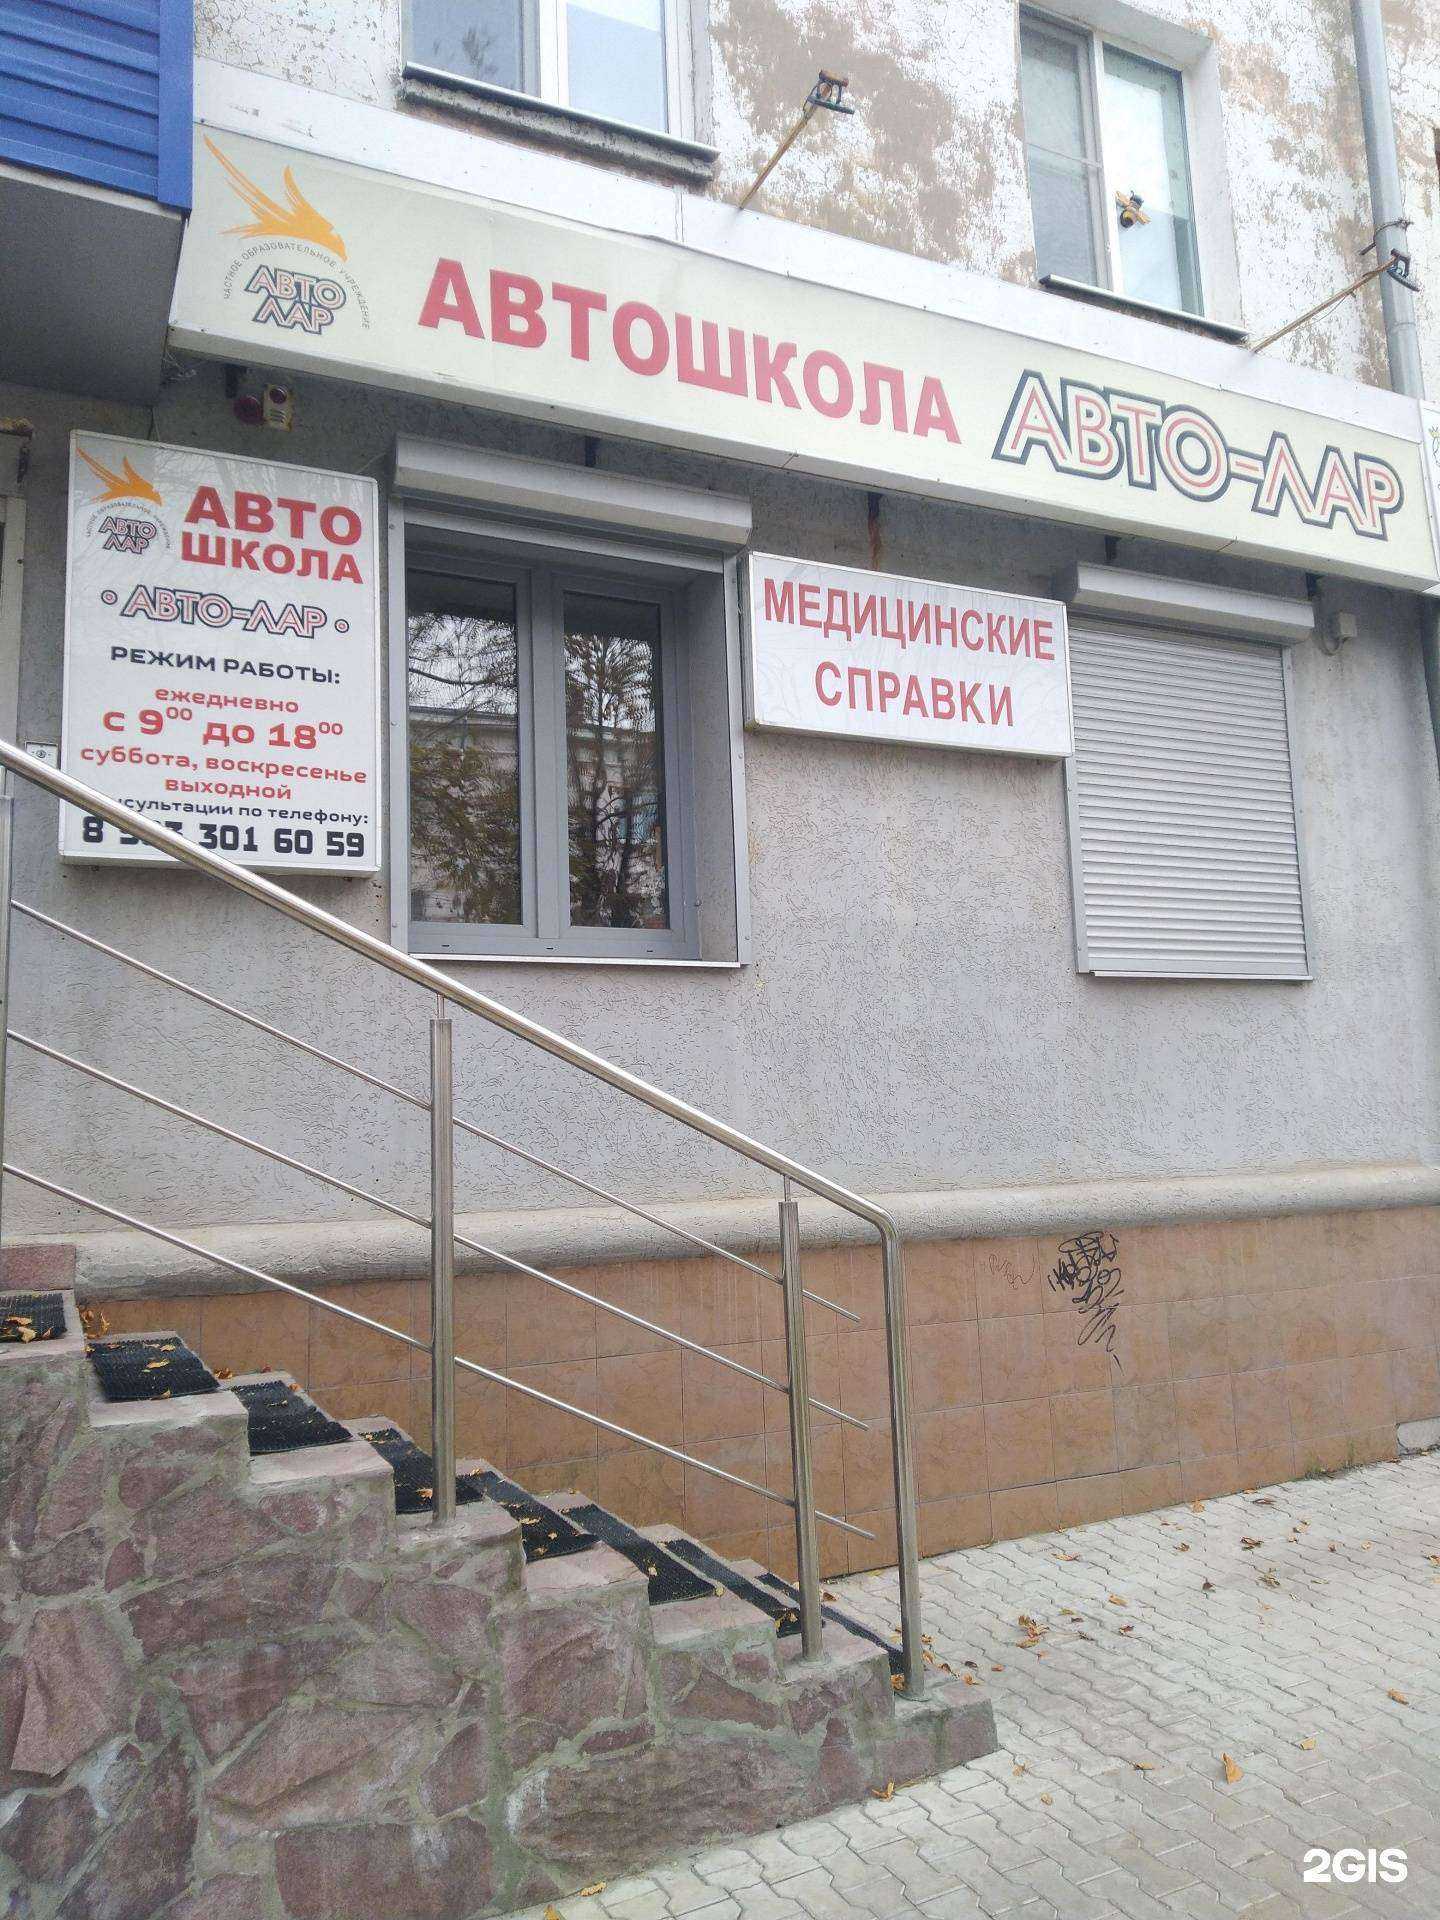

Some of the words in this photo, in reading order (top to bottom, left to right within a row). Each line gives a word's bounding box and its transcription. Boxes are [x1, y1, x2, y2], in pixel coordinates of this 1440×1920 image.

[244, 264, 347, 310] АВТО
[417, 257, 962, 444] АВТОШКОЛА
[991, 369, 1404, 542] АВТО-ЛАР
[98, 515, 157, 540] АВТО
[184, 485, 362, 546] АВТО
[181, 531, 363, 584] ШКОЛА
[763, 578, 1056, 661] МЕДИЦИНСКИЕ
[110, 646, 216, 672] РЕЖИМ
[223, 658, 341, 684] РАБОТЫ:
[155, 688, 299, 713] ежедневно
[814, 661, 1014, 727] СПРАВКИ
[80, 746, 198, 773] суббота,
[205, 757, 368, 784] воскресенье
[165, 778, 292, 800] выходной
[117, 798, 233, 816] сультации
[238, 806, 263, 819] по
[268, 807, 369, 826] телефону:
[82, 815, 104, 843] 8
[199, 823, 259, 853] 301
[273, 827, 314, 856] 60
[325, 831, 365, 858] 59
